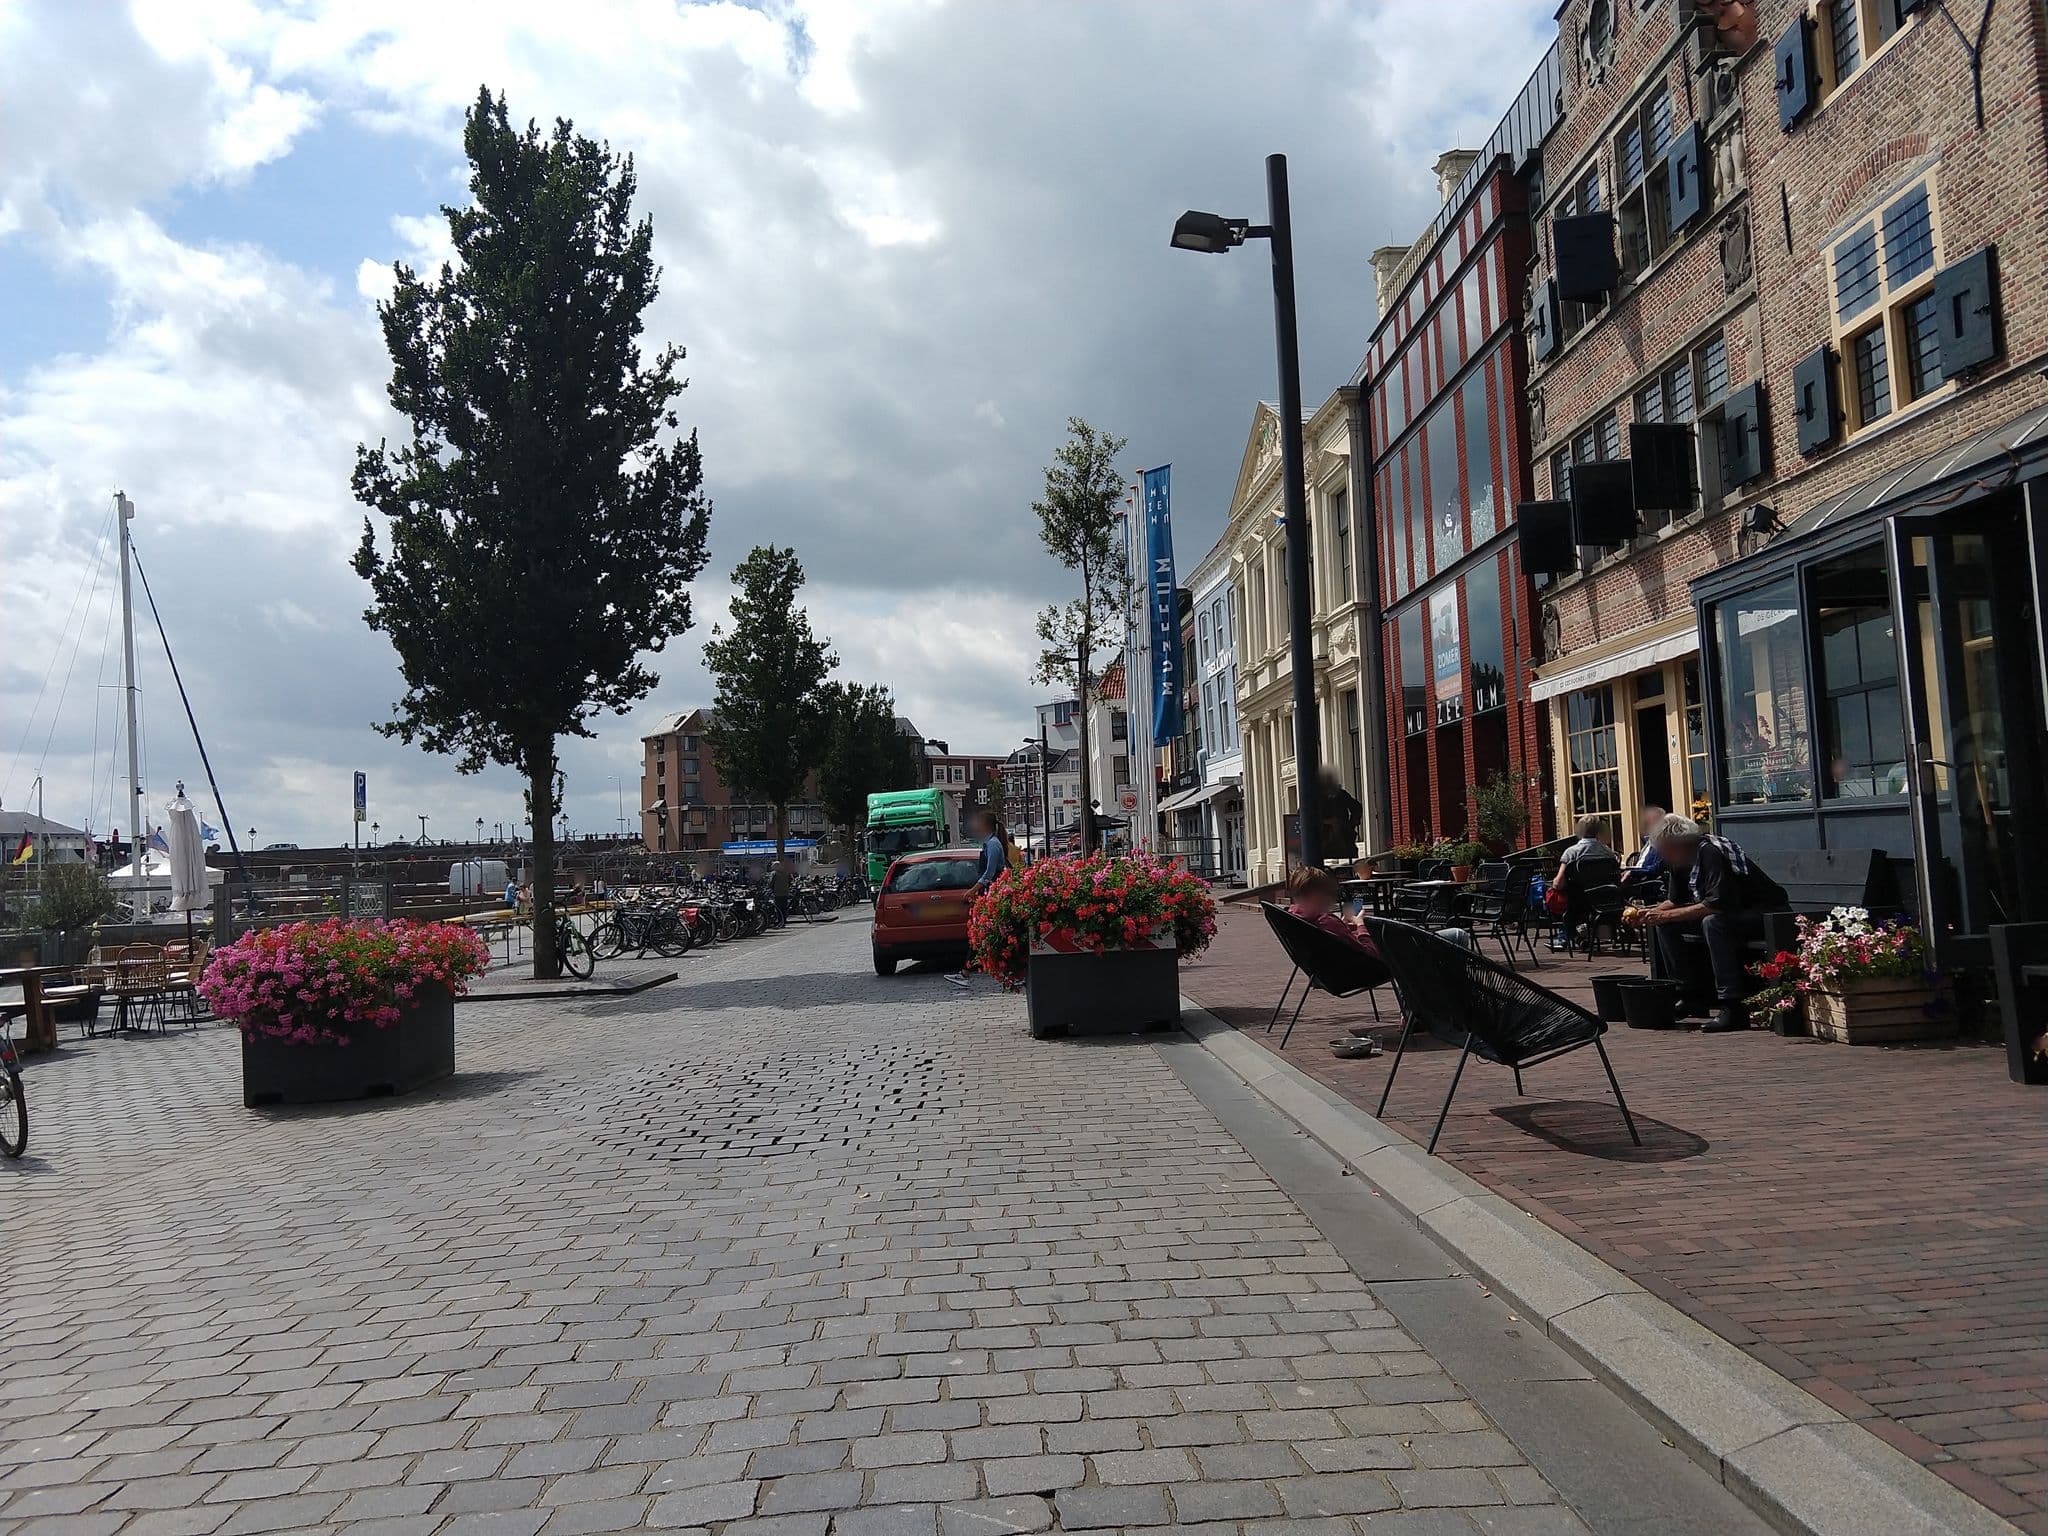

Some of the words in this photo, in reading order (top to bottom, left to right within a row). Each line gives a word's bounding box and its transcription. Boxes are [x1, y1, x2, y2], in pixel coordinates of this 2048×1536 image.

[1437, 647, 1459, 670] ZOMER
[1407, 711, 1422, 734] MU
[1437, 696, 1460, 725] ZEE
[1476, 684, 1499, 711] UM
[357, 775, 364, 793] P
